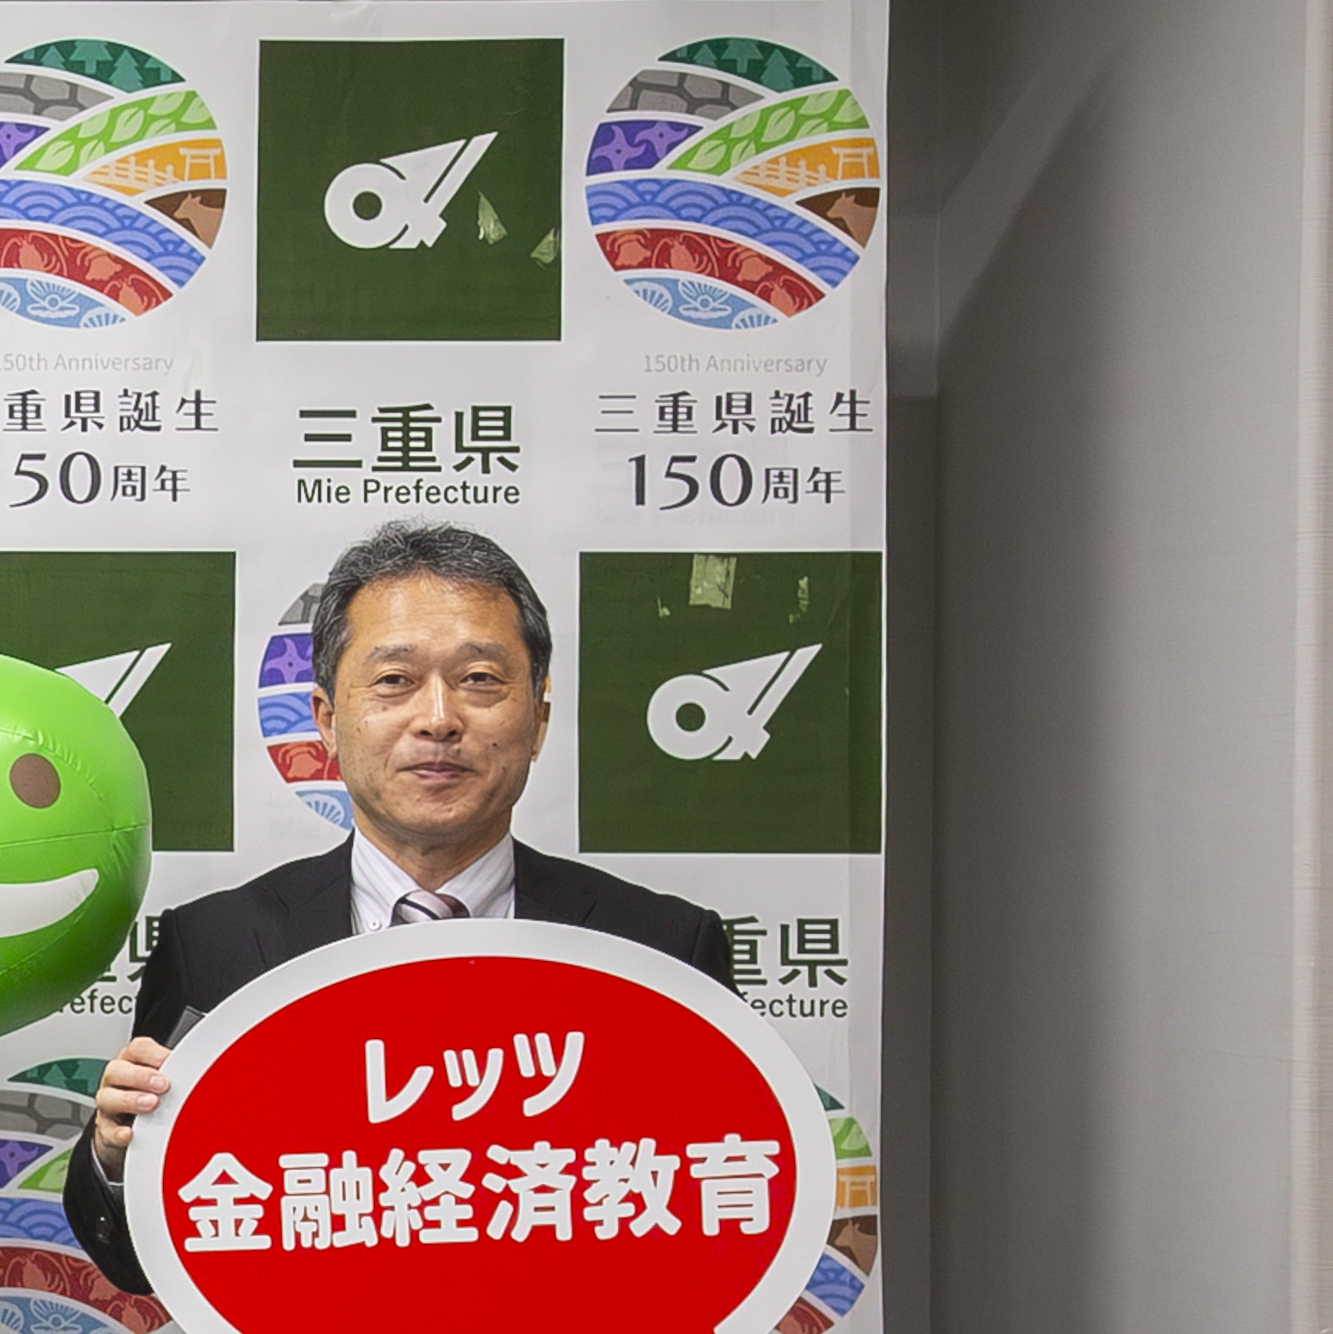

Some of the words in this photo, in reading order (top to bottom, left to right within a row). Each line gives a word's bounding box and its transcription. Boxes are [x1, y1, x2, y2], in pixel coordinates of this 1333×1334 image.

[54, 353, 174, 376] Anniversary
[645, 354, 699, 372] 150th
[706, 354, 827, 377] Anniversary
[595, 389, 873, 434] 三重県誕生
[293, 404, 520, 474] 三重県
[298, 478, 350, 503] Mie
[364, 479, 519, 504] Prefecture
[629, 454, 844, 510] 150周年
[723, 914, 849, 990] 重県
[742, 991, 849, 1018] ecture
[364, 1030, 586, 1125] レッツ
[176, 1133, 782, 1254] 金融経済教育
